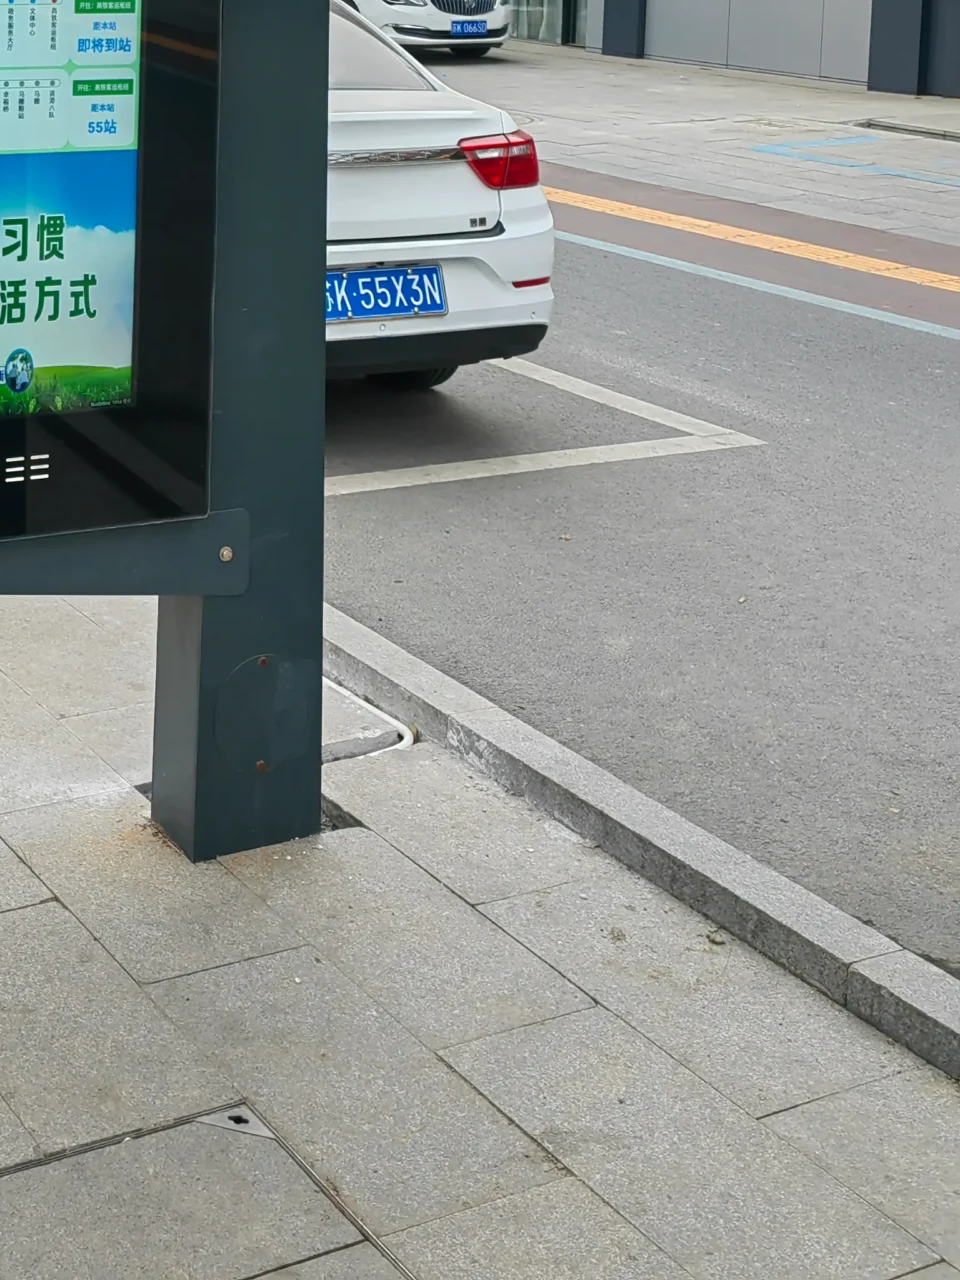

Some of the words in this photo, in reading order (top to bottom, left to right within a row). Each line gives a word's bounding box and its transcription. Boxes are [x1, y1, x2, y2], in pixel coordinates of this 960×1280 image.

[93, 21, 117, 31] 距本站
[77, 37, 132, 53] 即将到站
[90, 103, 115, 113] 距本站
[87, 119, 117, 135] 55站
